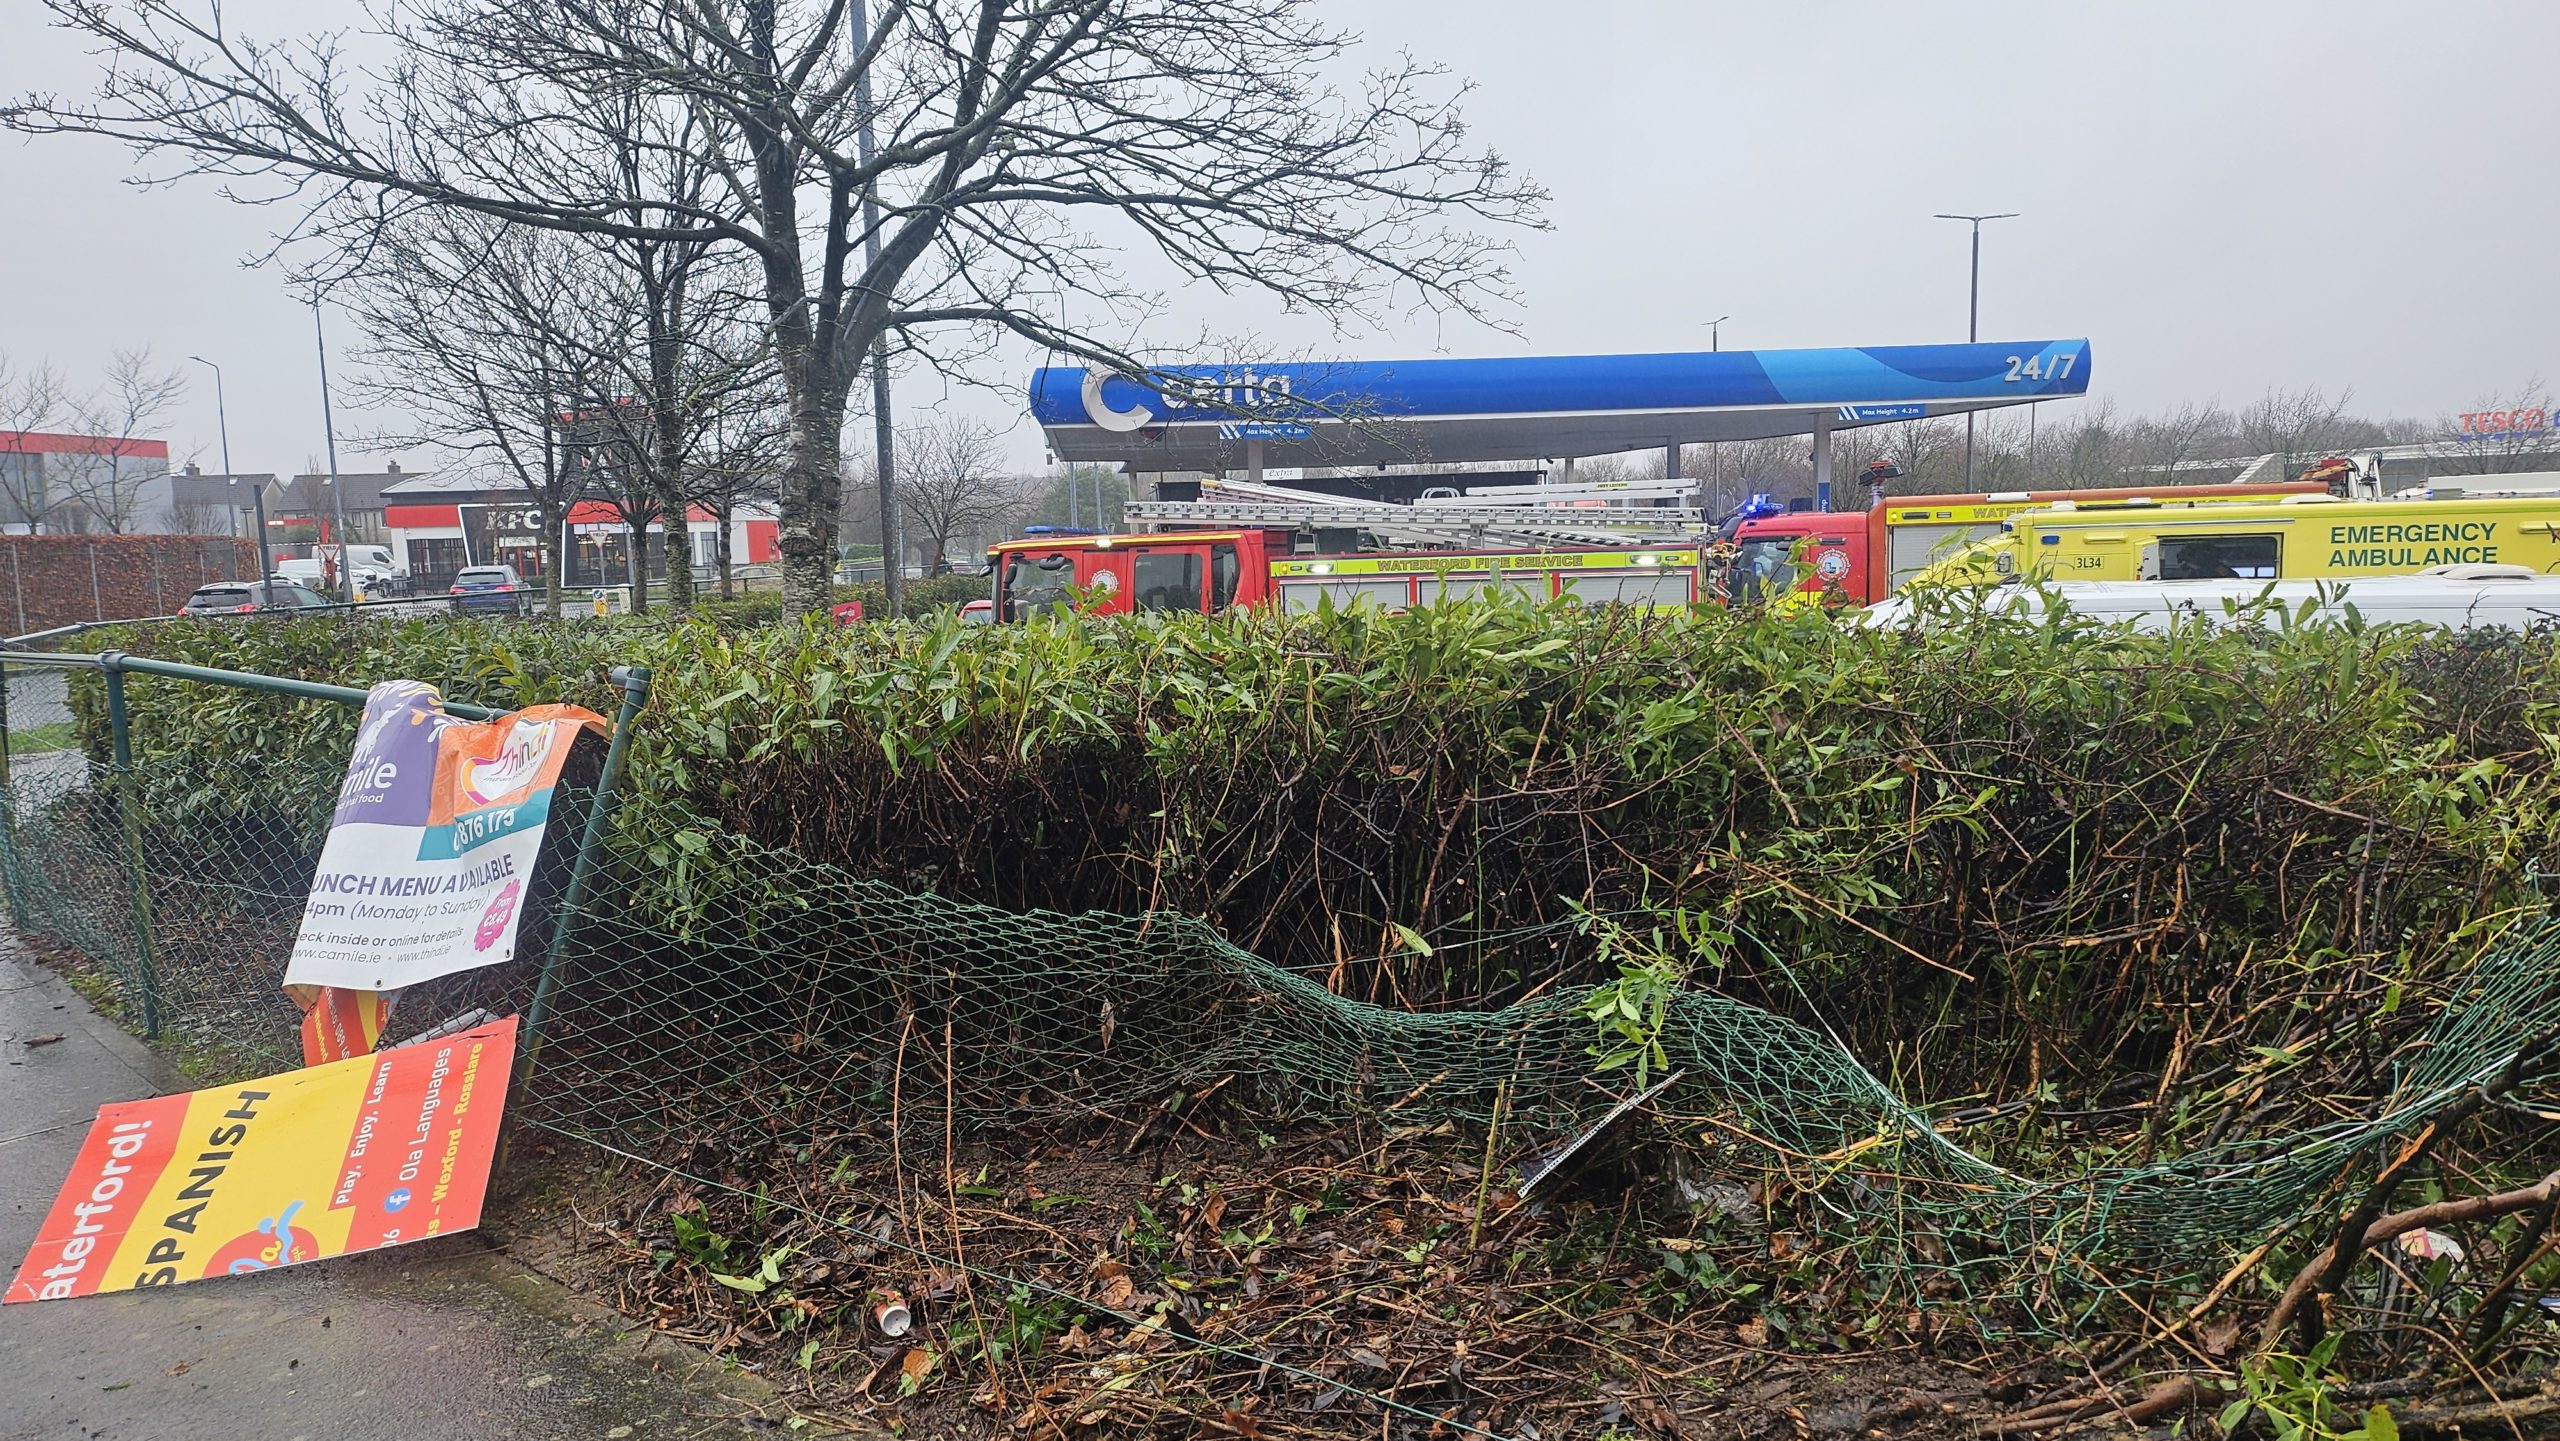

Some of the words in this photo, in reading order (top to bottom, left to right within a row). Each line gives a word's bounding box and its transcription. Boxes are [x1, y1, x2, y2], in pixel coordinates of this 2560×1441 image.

[2005, 354, 2077, 381] 24/7
[1876, 408, 1898, 416] Height
[2459, 408, 2545, 433] TESCO
[485, 509, 542, 530] KFC
[2330, 522, 2497, 544] EMERGENCY
[1377, 557, 1471, 572] WATERFORD
[1514, 555, 1584, 568] SERVICE
[2077, 557, 2101, 568] 3L34
[2328, 546, 2498, 568] AMBULANCE
[339, 755, 397, 798] mile
[379, 874, 443, 896] MENU
[350, 899, 423, 923] (Monday
[424, 904, 437, 917] to
[440, 889, 490, 915] Sunday)
[327, 932, 369, 945] inside
[372, 938, 387, 947] or
[388, 934, 419, 947] online
[420, 932, 435, 944] for
[435, 926, 463, 941] details
[408, 1047, 451, 1145] Languages
[335, 1164, 361, 1205] Play,
[350, 1110, 379, 1158] Enjoy,
[367, 1060, 393, 1105] Learn
[432, 1127, 463, 1202] Wexford
[453, 1042, 484, 1115] Rosslare
[399, 1149, 424, 1181] Ola
[135, 1090, 271, 1289] SPANISH
